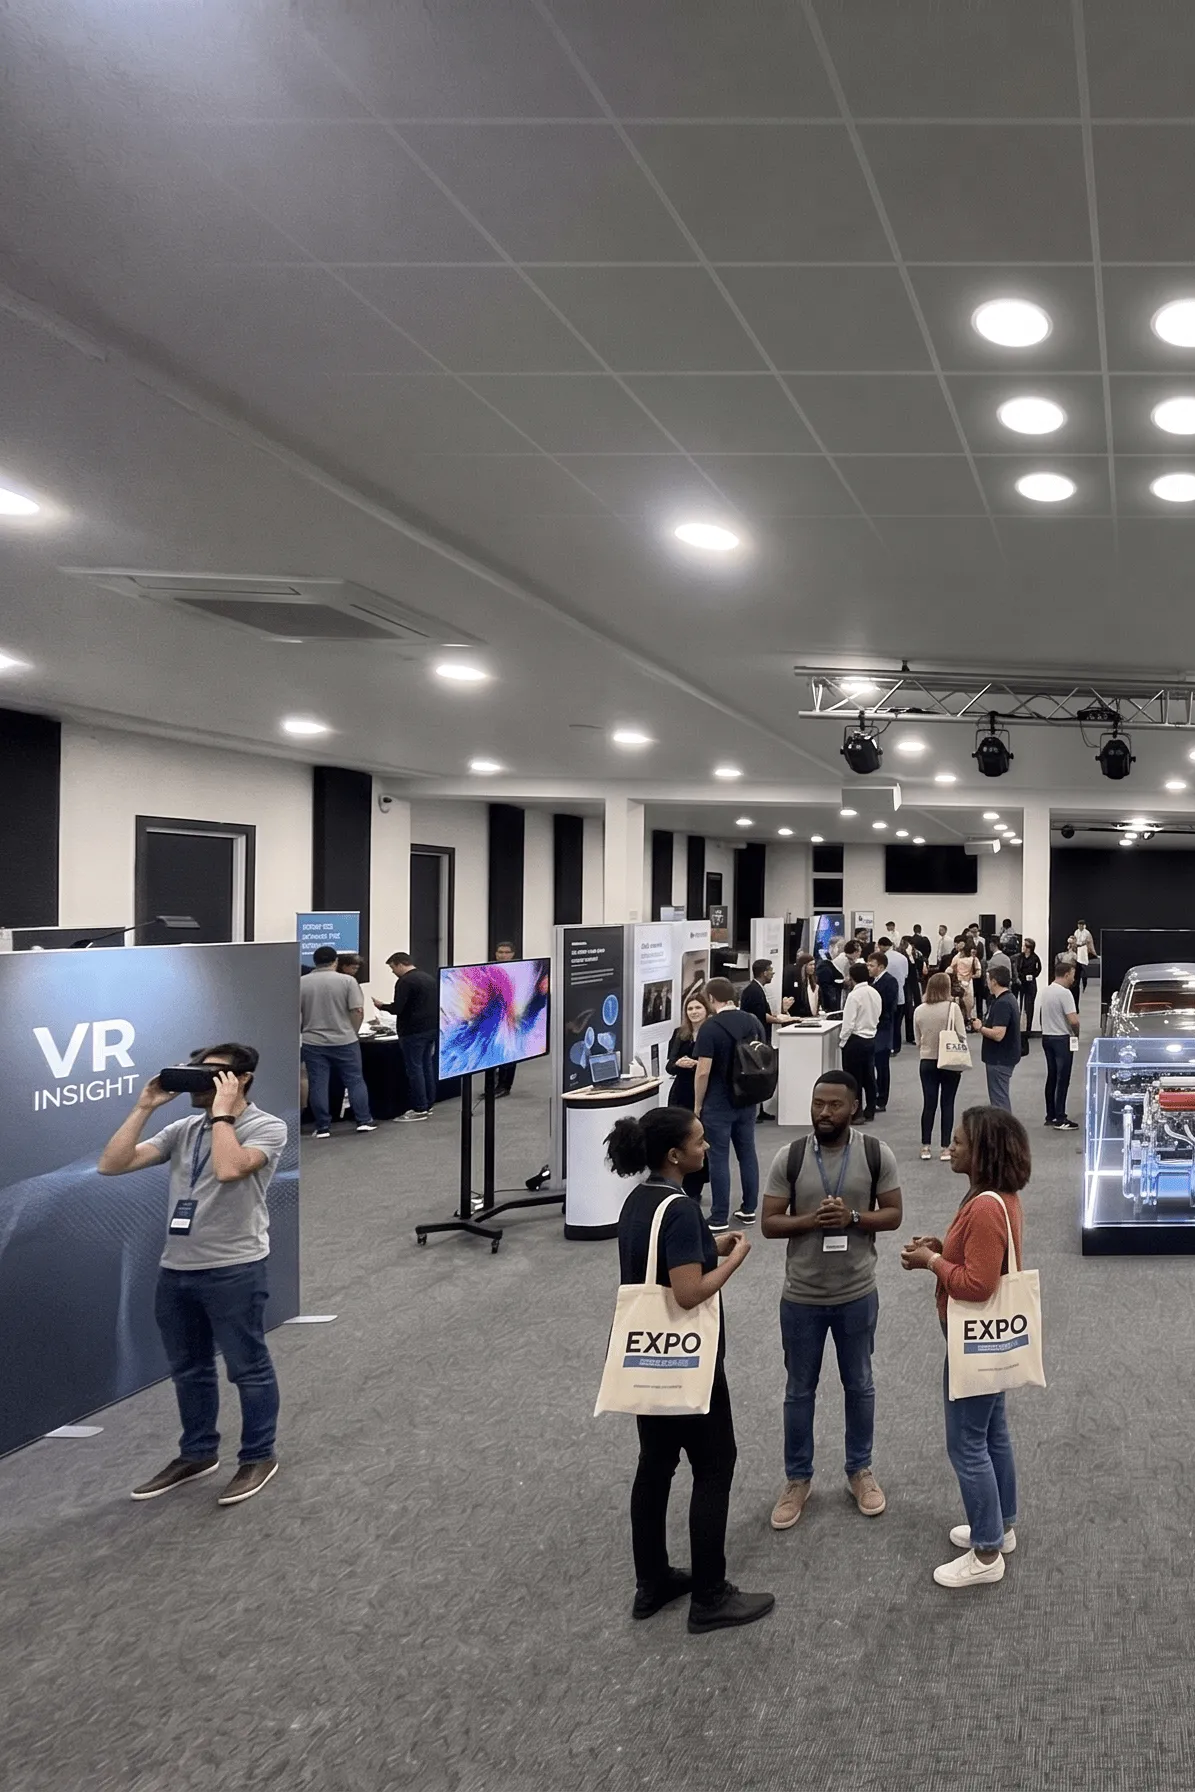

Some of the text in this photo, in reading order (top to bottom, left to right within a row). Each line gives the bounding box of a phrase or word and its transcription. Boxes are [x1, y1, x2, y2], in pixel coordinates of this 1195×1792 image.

[33, 1019, 135, 1078] VR
[34, 1074, 139, 1111] INSIGHT
[625, 1331, 702, 1354] EXPO
[963, 1314, 1028, 1340] EXPO
